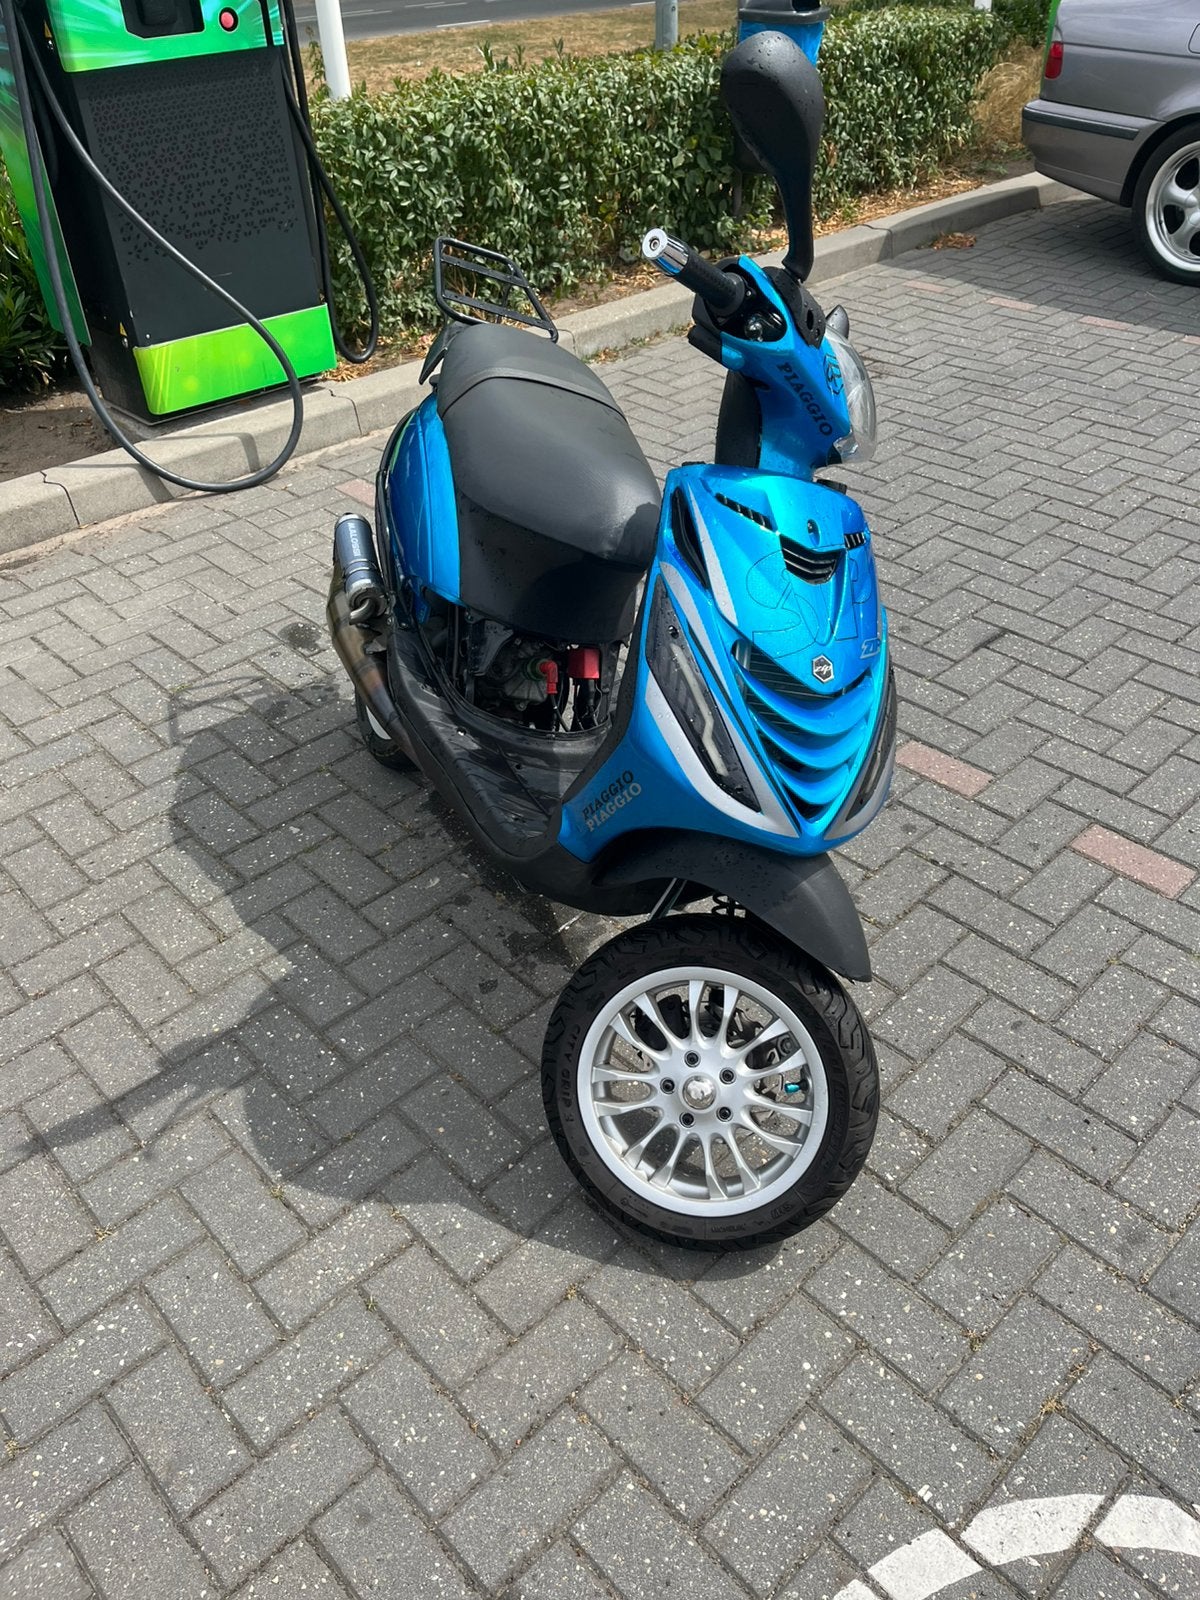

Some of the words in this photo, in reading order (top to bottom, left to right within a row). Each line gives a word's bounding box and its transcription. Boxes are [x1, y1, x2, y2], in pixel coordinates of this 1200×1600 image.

[776, 362, 833, 436] PIAGGIO
[347, 522, 361, 557] MALOSSI
[582, 770, 634, 820] PIAGGIO
[586, 782, 642, 832] PIAGGIO
[564, 1024, 581, 1062] CITY
[561, 1068, 573, 1108] GRIP
